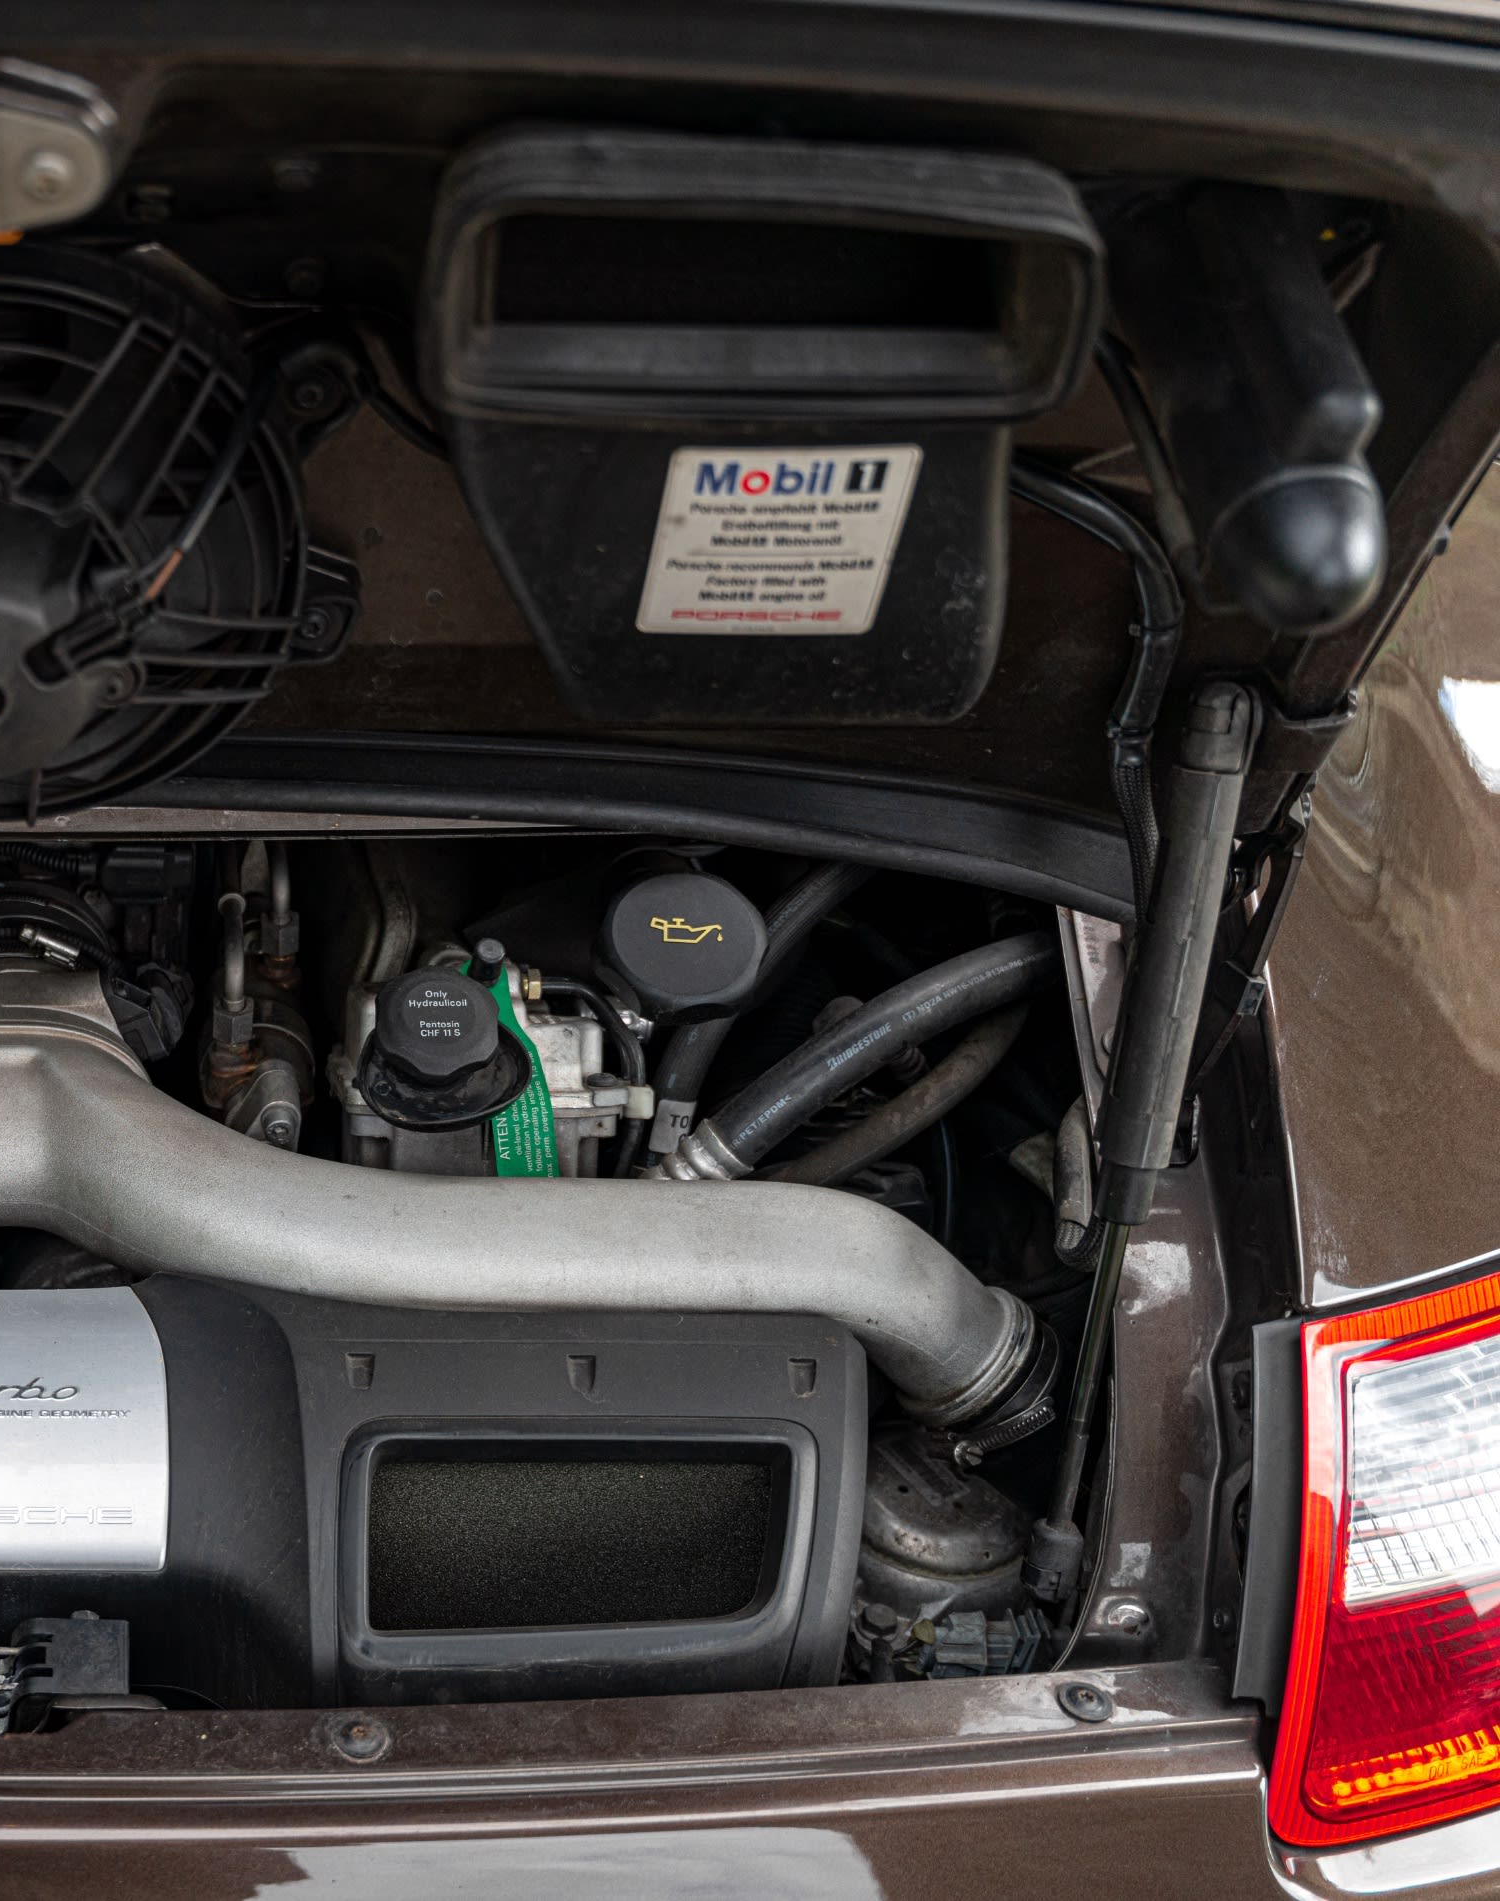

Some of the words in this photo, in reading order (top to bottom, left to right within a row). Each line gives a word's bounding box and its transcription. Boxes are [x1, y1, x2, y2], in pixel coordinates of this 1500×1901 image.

[693, 461, 835, 496] Mobil
[799, 576, 826, 586] with
[671, 609, 842, 622] PORSCHE
[425, 990, 447, 999] Only
[408, 999, 467, 1008] Hydraulicoil
[420, 1020, 460, 1028] Pentosin
[420, 1029, 440, 1037] CHF
[443, 1029, 451, 1037] 11
[453, 1028, 461, 1037] S
[827, 1022, 892, 1072] BRIDGESTONE
[535, 1080, 549, 1132] overpressure
[531, 1106, 541, 1145] operating
[523, 1131, 533, 1172] ventilation
[534, 1151, 543, 1172] follow
[39, 1408, 131, 1419] GEOMETRY
[1428, 1761, 1451, 1780] DOT
[1460, 1751, 1485, 1769] SAE
